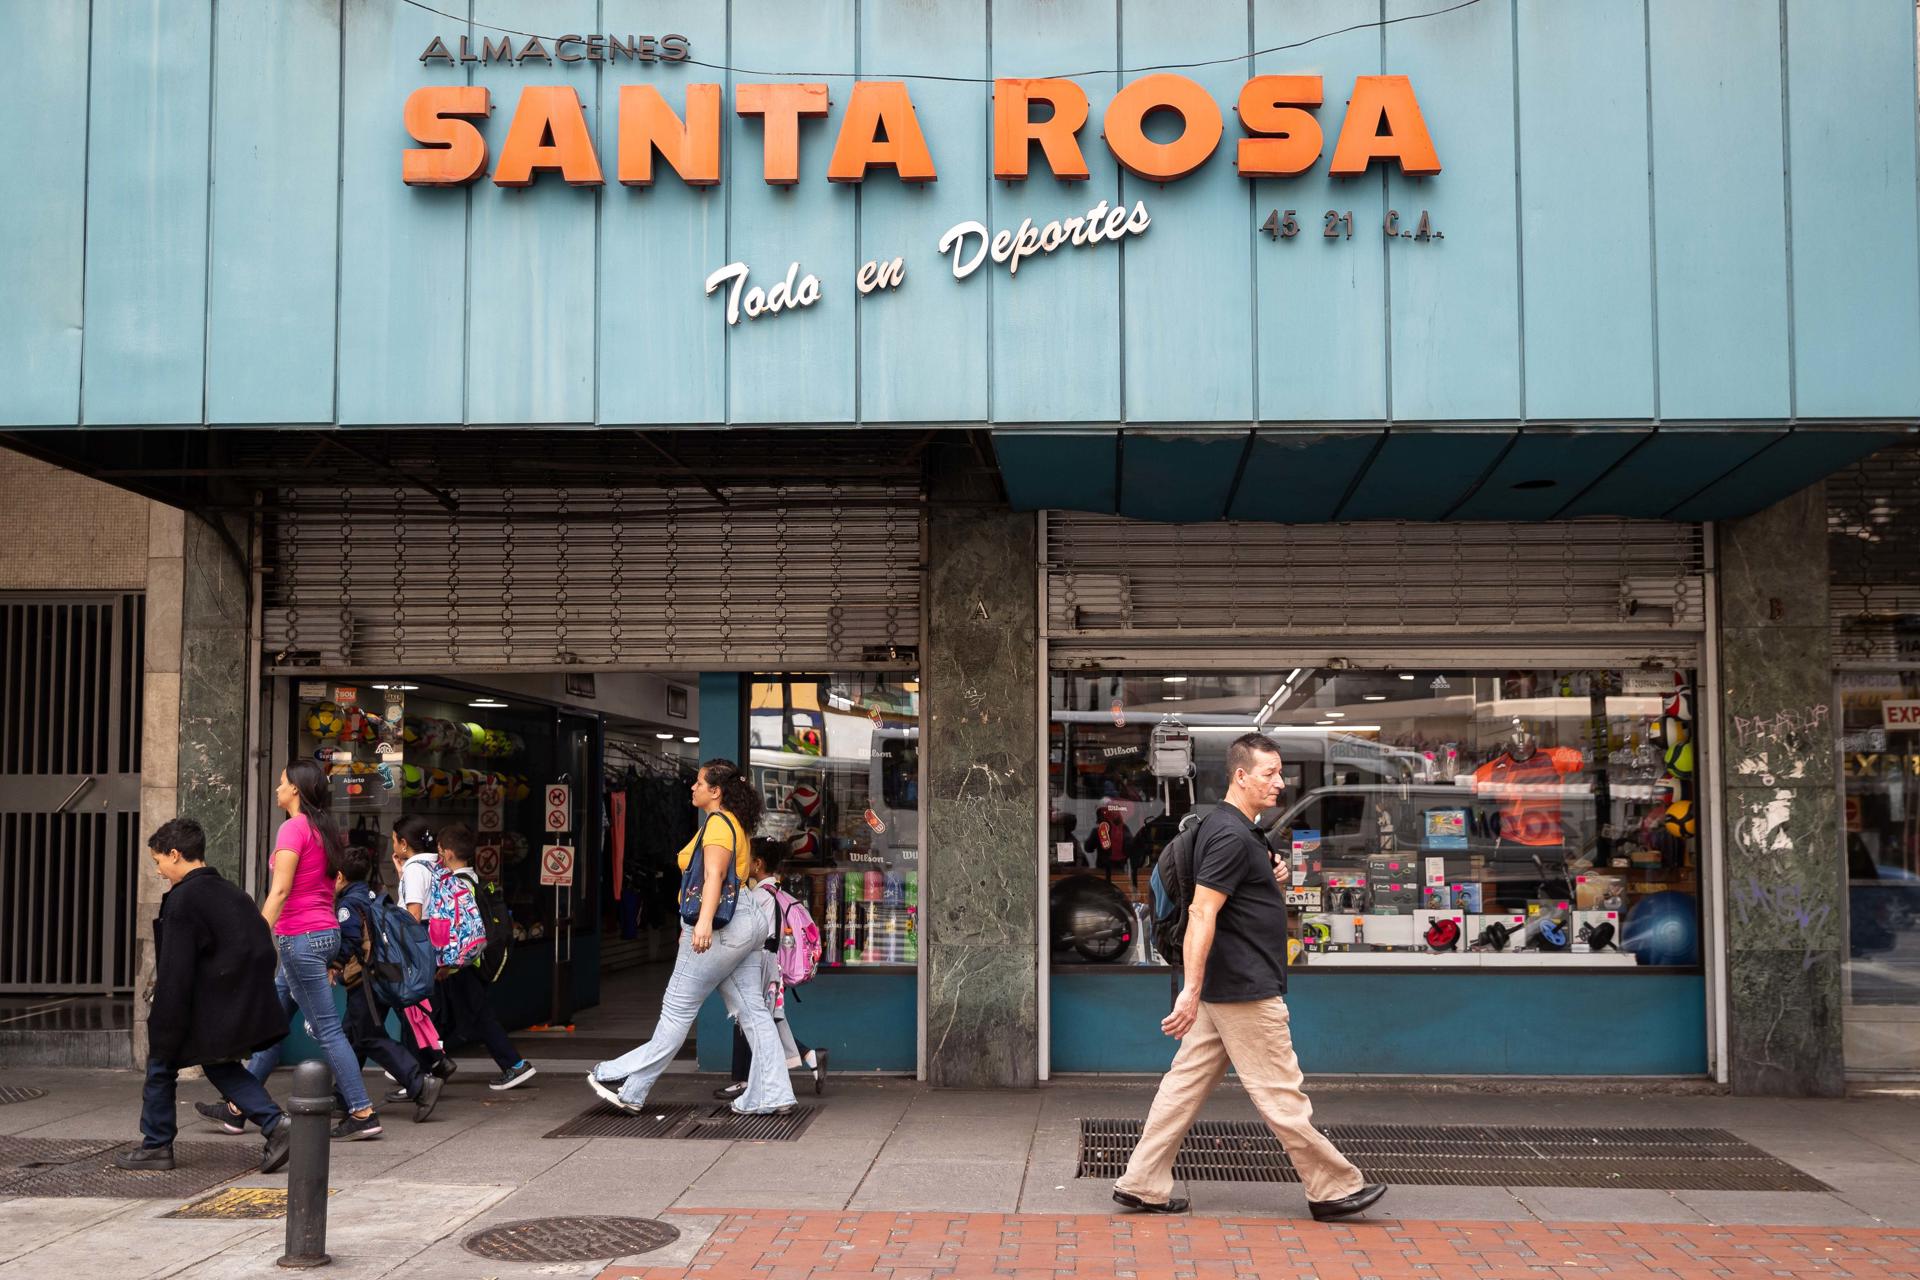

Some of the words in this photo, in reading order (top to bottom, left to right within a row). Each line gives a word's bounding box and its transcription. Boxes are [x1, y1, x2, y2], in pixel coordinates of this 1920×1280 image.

[419, 34, 690, 63] ALMACENES
[403, 81, 939, 187] SANTA
[993, 73, 1443, 182] ROSA
[1263, 209, 1299, 238] 45
[1323, 209, 1353, 238] 21
[1384, 210, 1444, 239] C.A.
[705, 261, 822, 325] Todo
[856, 256, 906, 295] en
[938, 199, 1153, 280] Deportes
[971, 600, 989, 619] A
[1103, 745, 1138, 758] Wilson
[849, 851, 884, 863] Wilson
